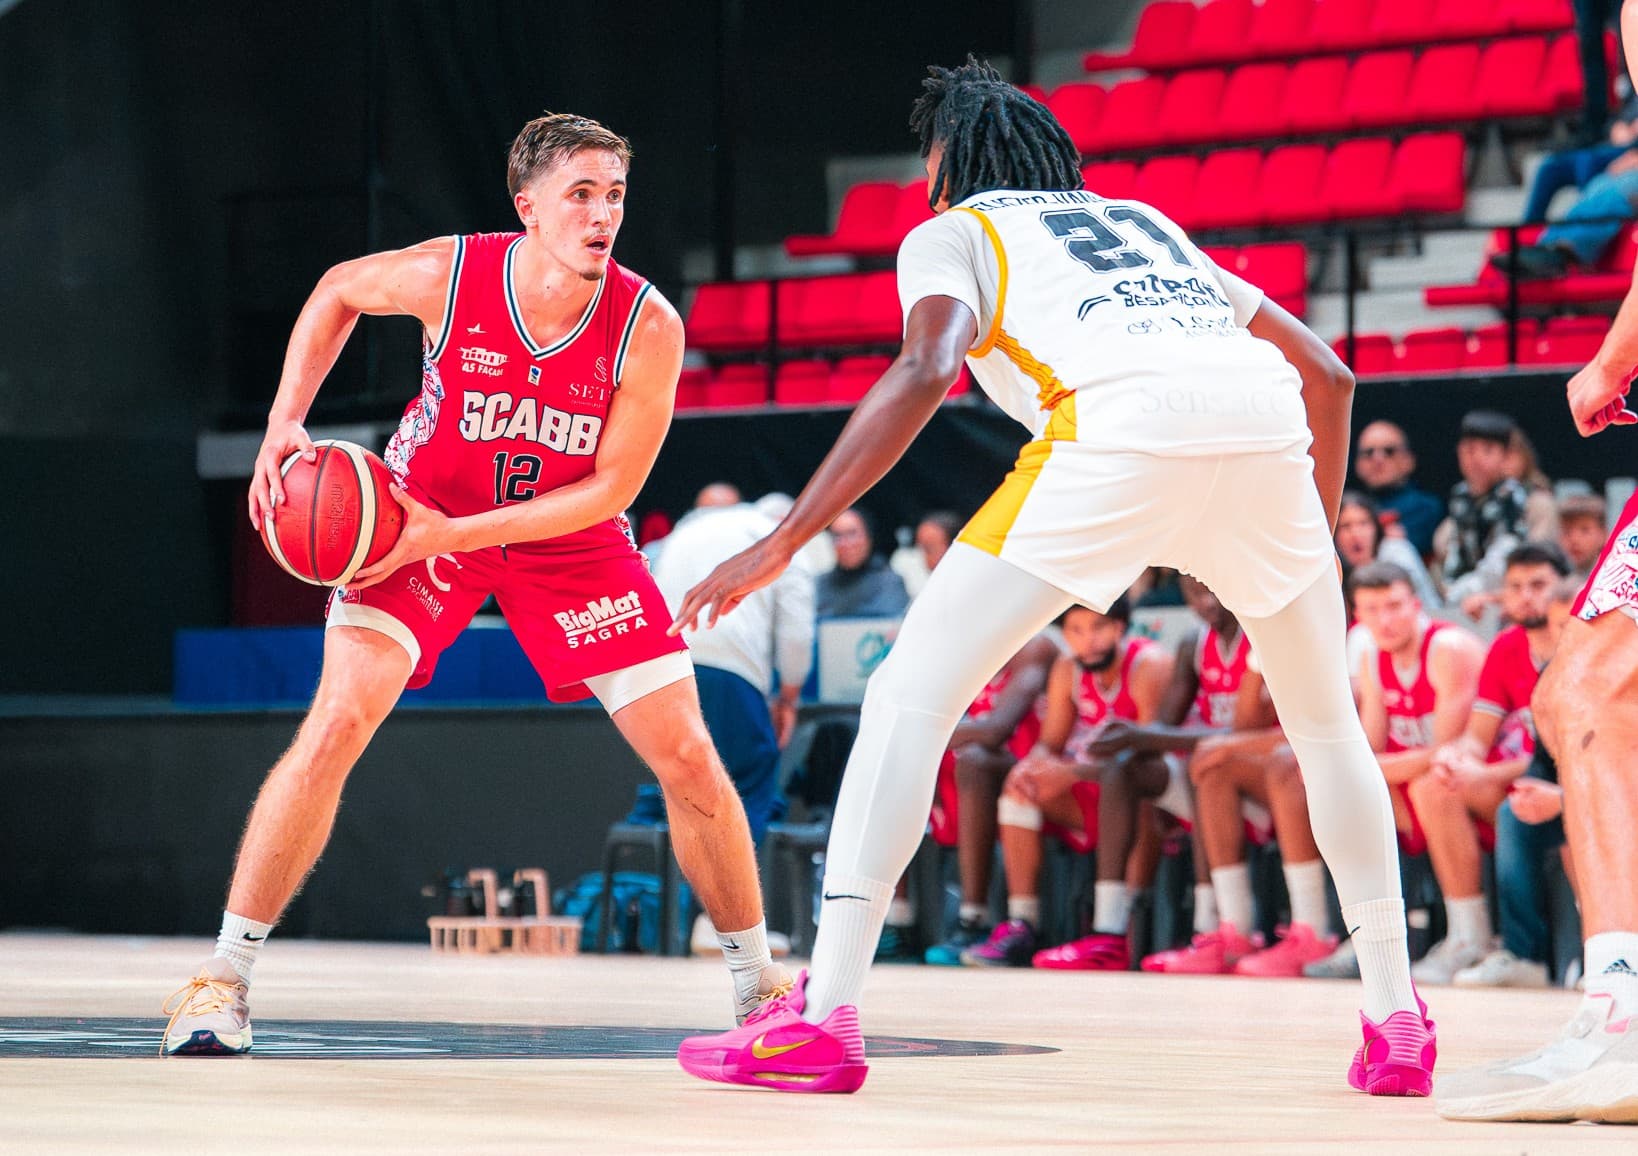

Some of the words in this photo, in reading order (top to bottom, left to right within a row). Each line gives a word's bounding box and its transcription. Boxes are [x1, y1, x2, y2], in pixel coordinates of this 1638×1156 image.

[1039, 205, 1197, 274] 21
[458, 391, 602, 456] SCABB
[492, 451, 544, 506] 12
[409, 576, 444, 616] CIMAISE
[553, 590, 641, 632] BigMat
[566, 616, 649, 650] SAGRA
